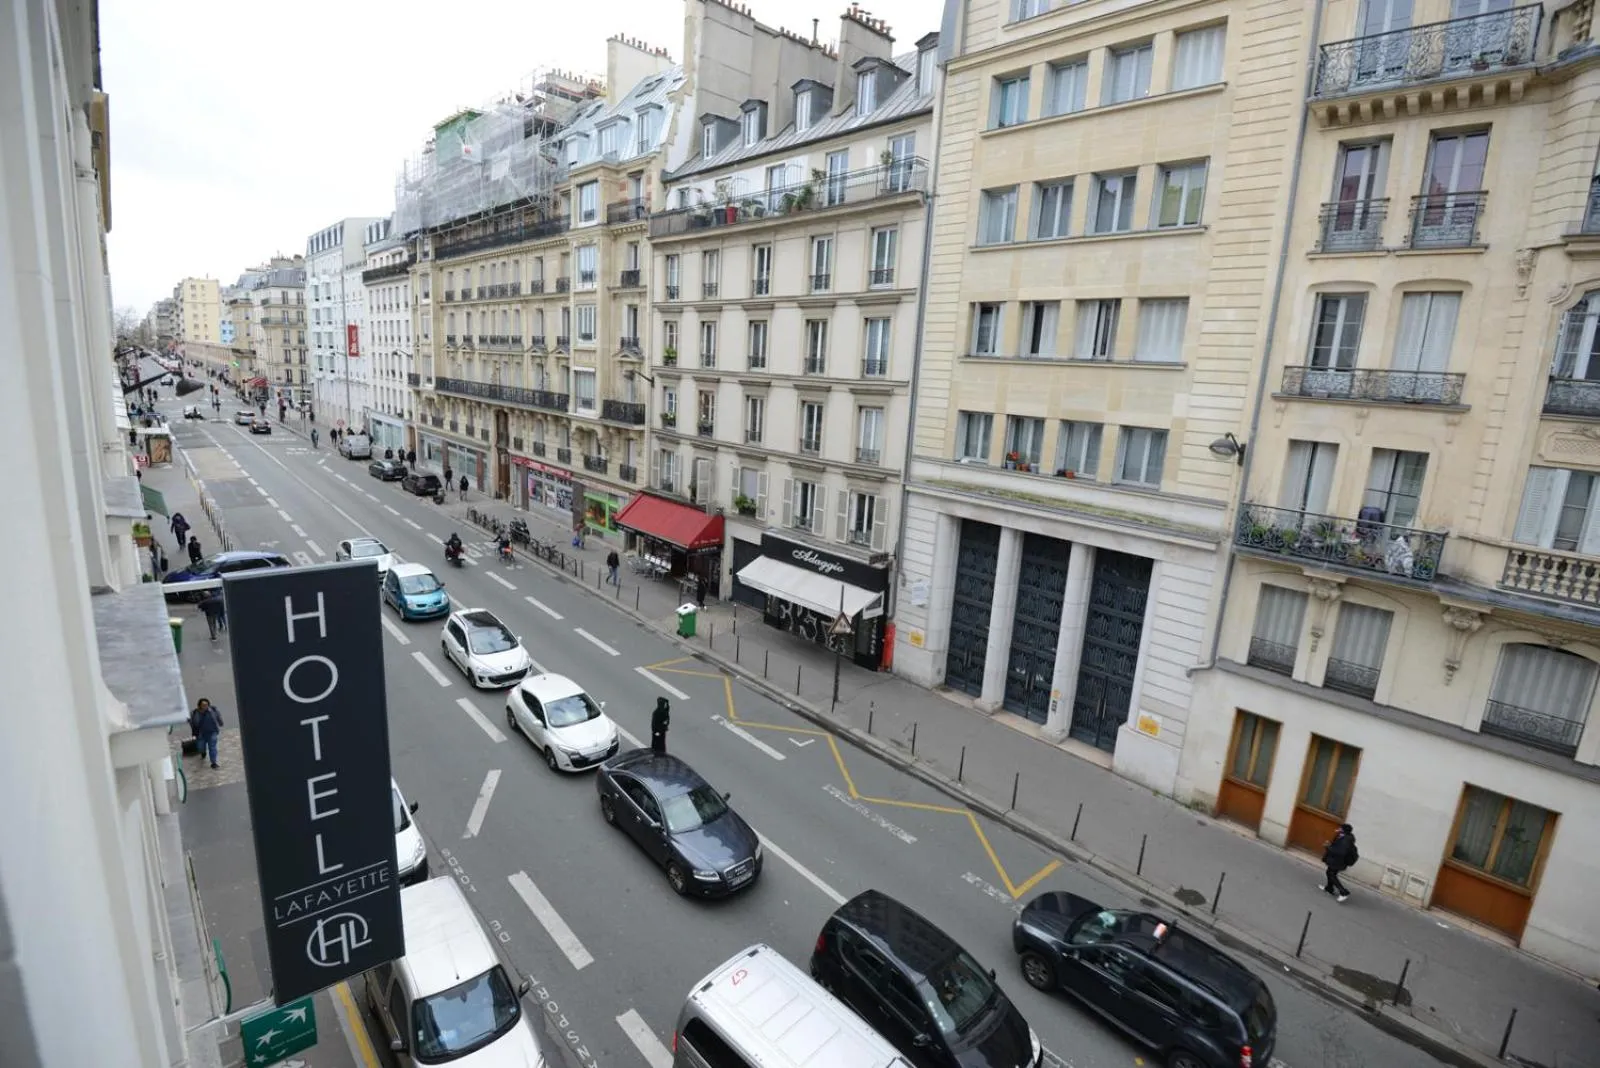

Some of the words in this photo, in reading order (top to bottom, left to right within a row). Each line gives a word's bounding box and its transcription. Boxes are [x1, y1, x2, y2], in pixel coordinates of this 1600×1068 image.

[283, 591, 344, 875] HOTEL
[274, 867, 390, 921] LAFAYETTE
[490, 920, 511, 943] DE
